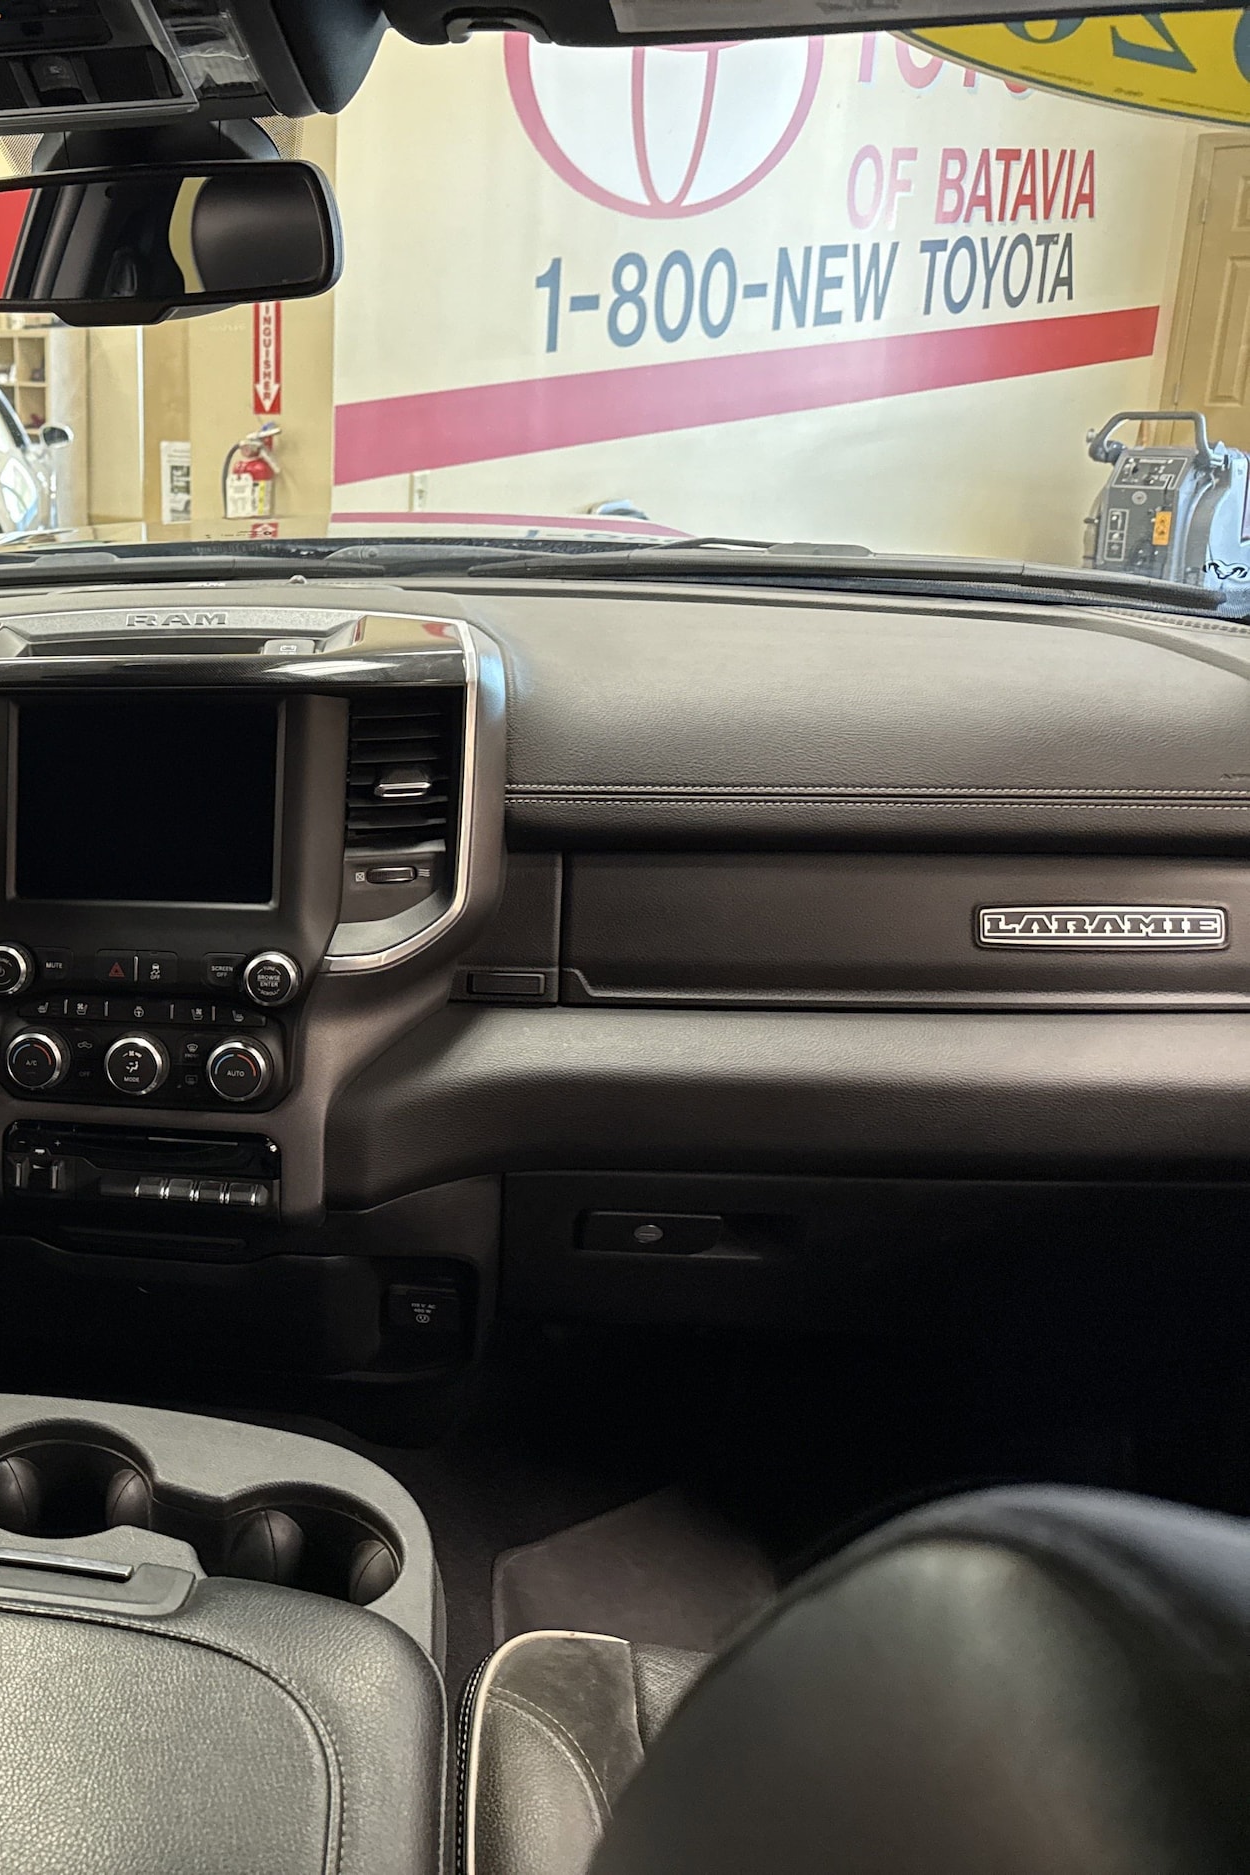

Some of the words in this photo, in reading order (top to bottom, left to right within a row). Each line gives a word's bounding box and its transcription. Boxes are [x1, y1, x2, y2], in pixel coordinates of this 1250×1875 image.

[847, 144, 918, 230] OF
[935, 148, 1096, 224] BATAVIA
[535, 241, 899, 353] 1-800-NEW
[921, 232, 1075, 316] TOYOTA
[126, 612, 229, 627] RAM
[984, 914, 1221, 937] LARAMIE
